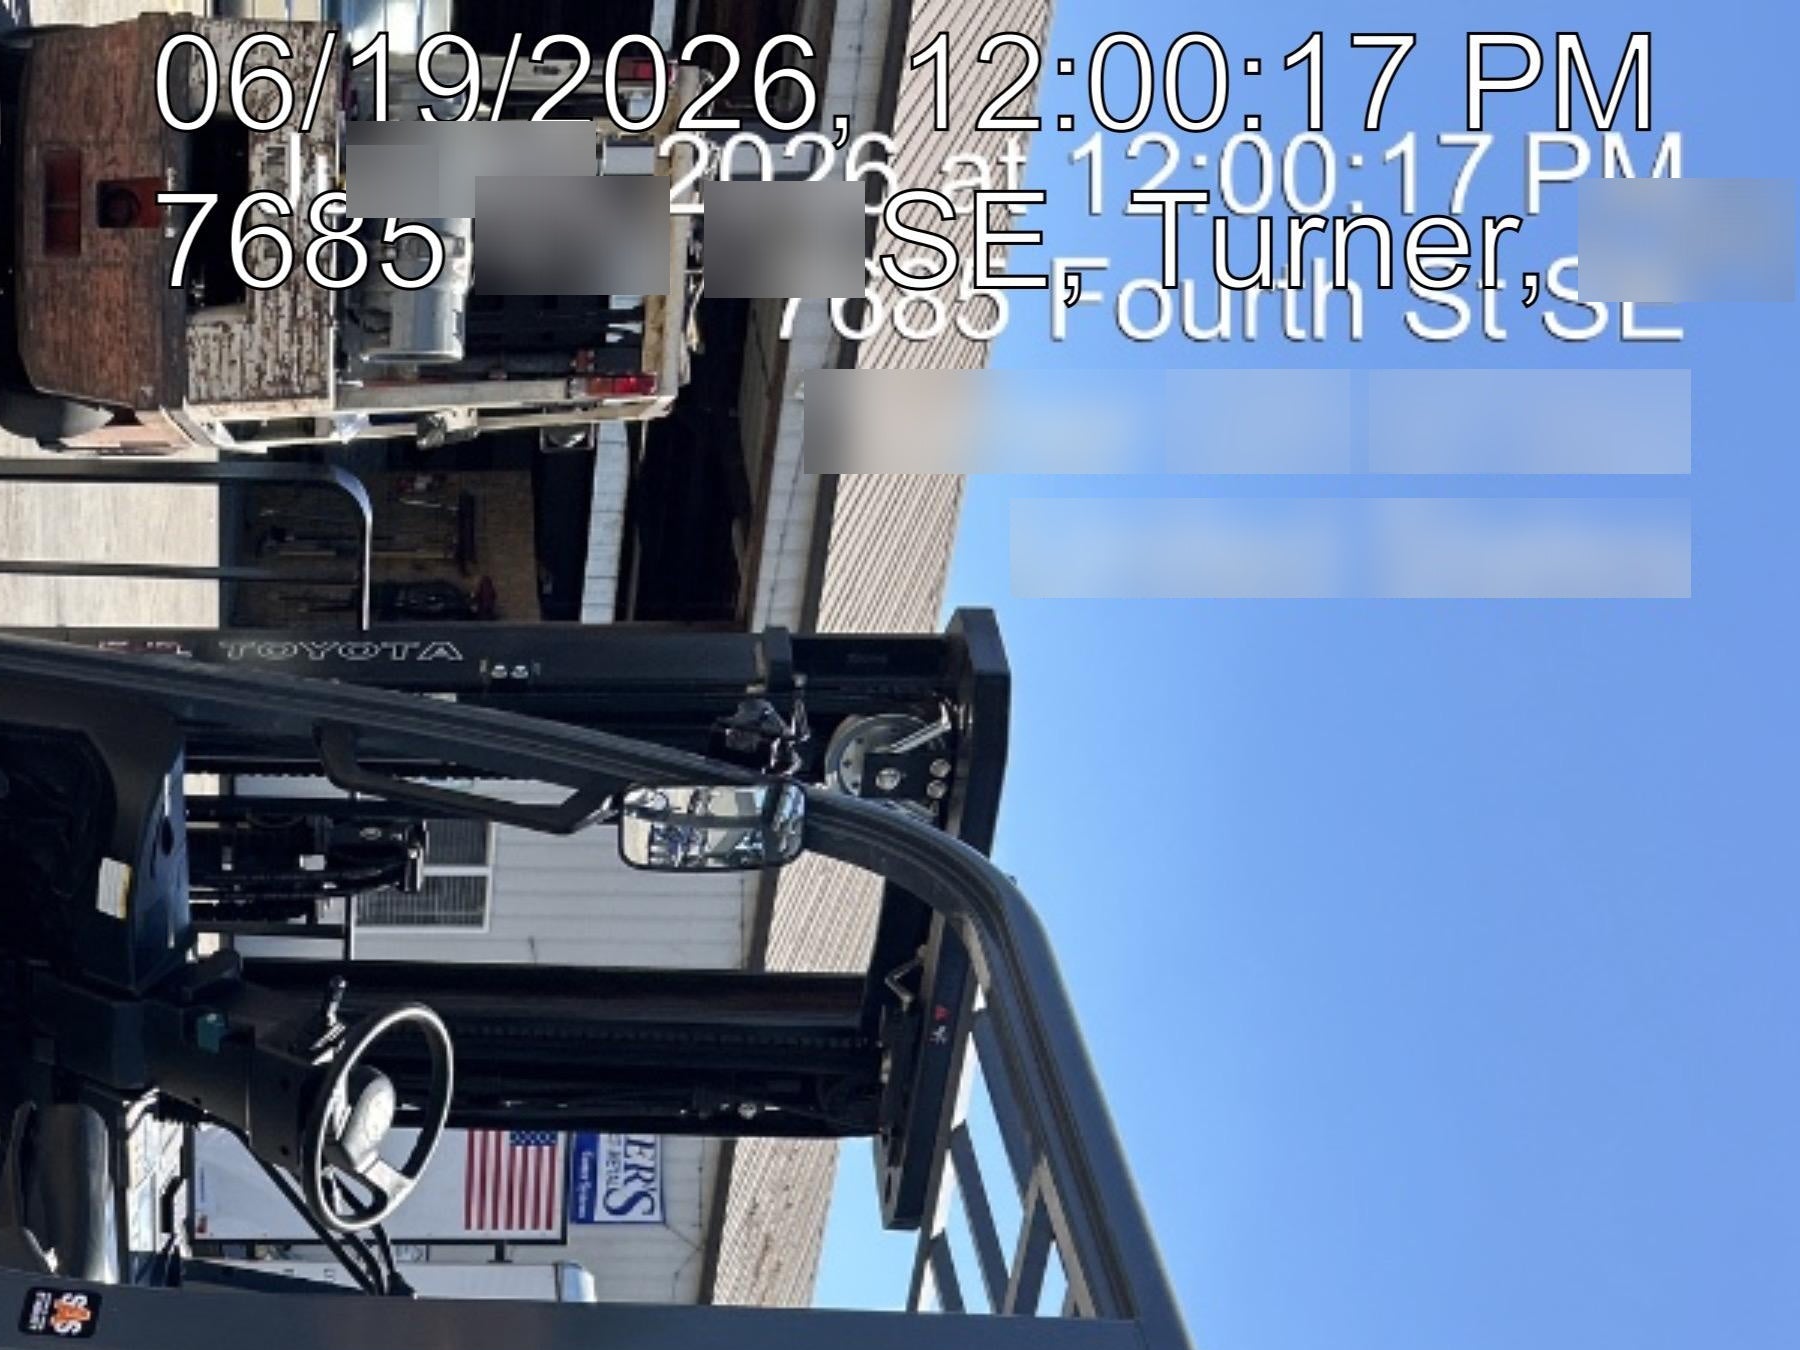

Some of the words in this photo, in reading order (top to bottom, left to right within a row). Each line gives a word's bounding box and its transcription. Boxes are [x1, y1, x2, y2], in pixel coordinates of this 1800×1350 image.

[220, 640, 463, 661] TOYOTA
[603, 1134, 657, 1216] ER'S
[48, 1293, 92, 1336] SAS
